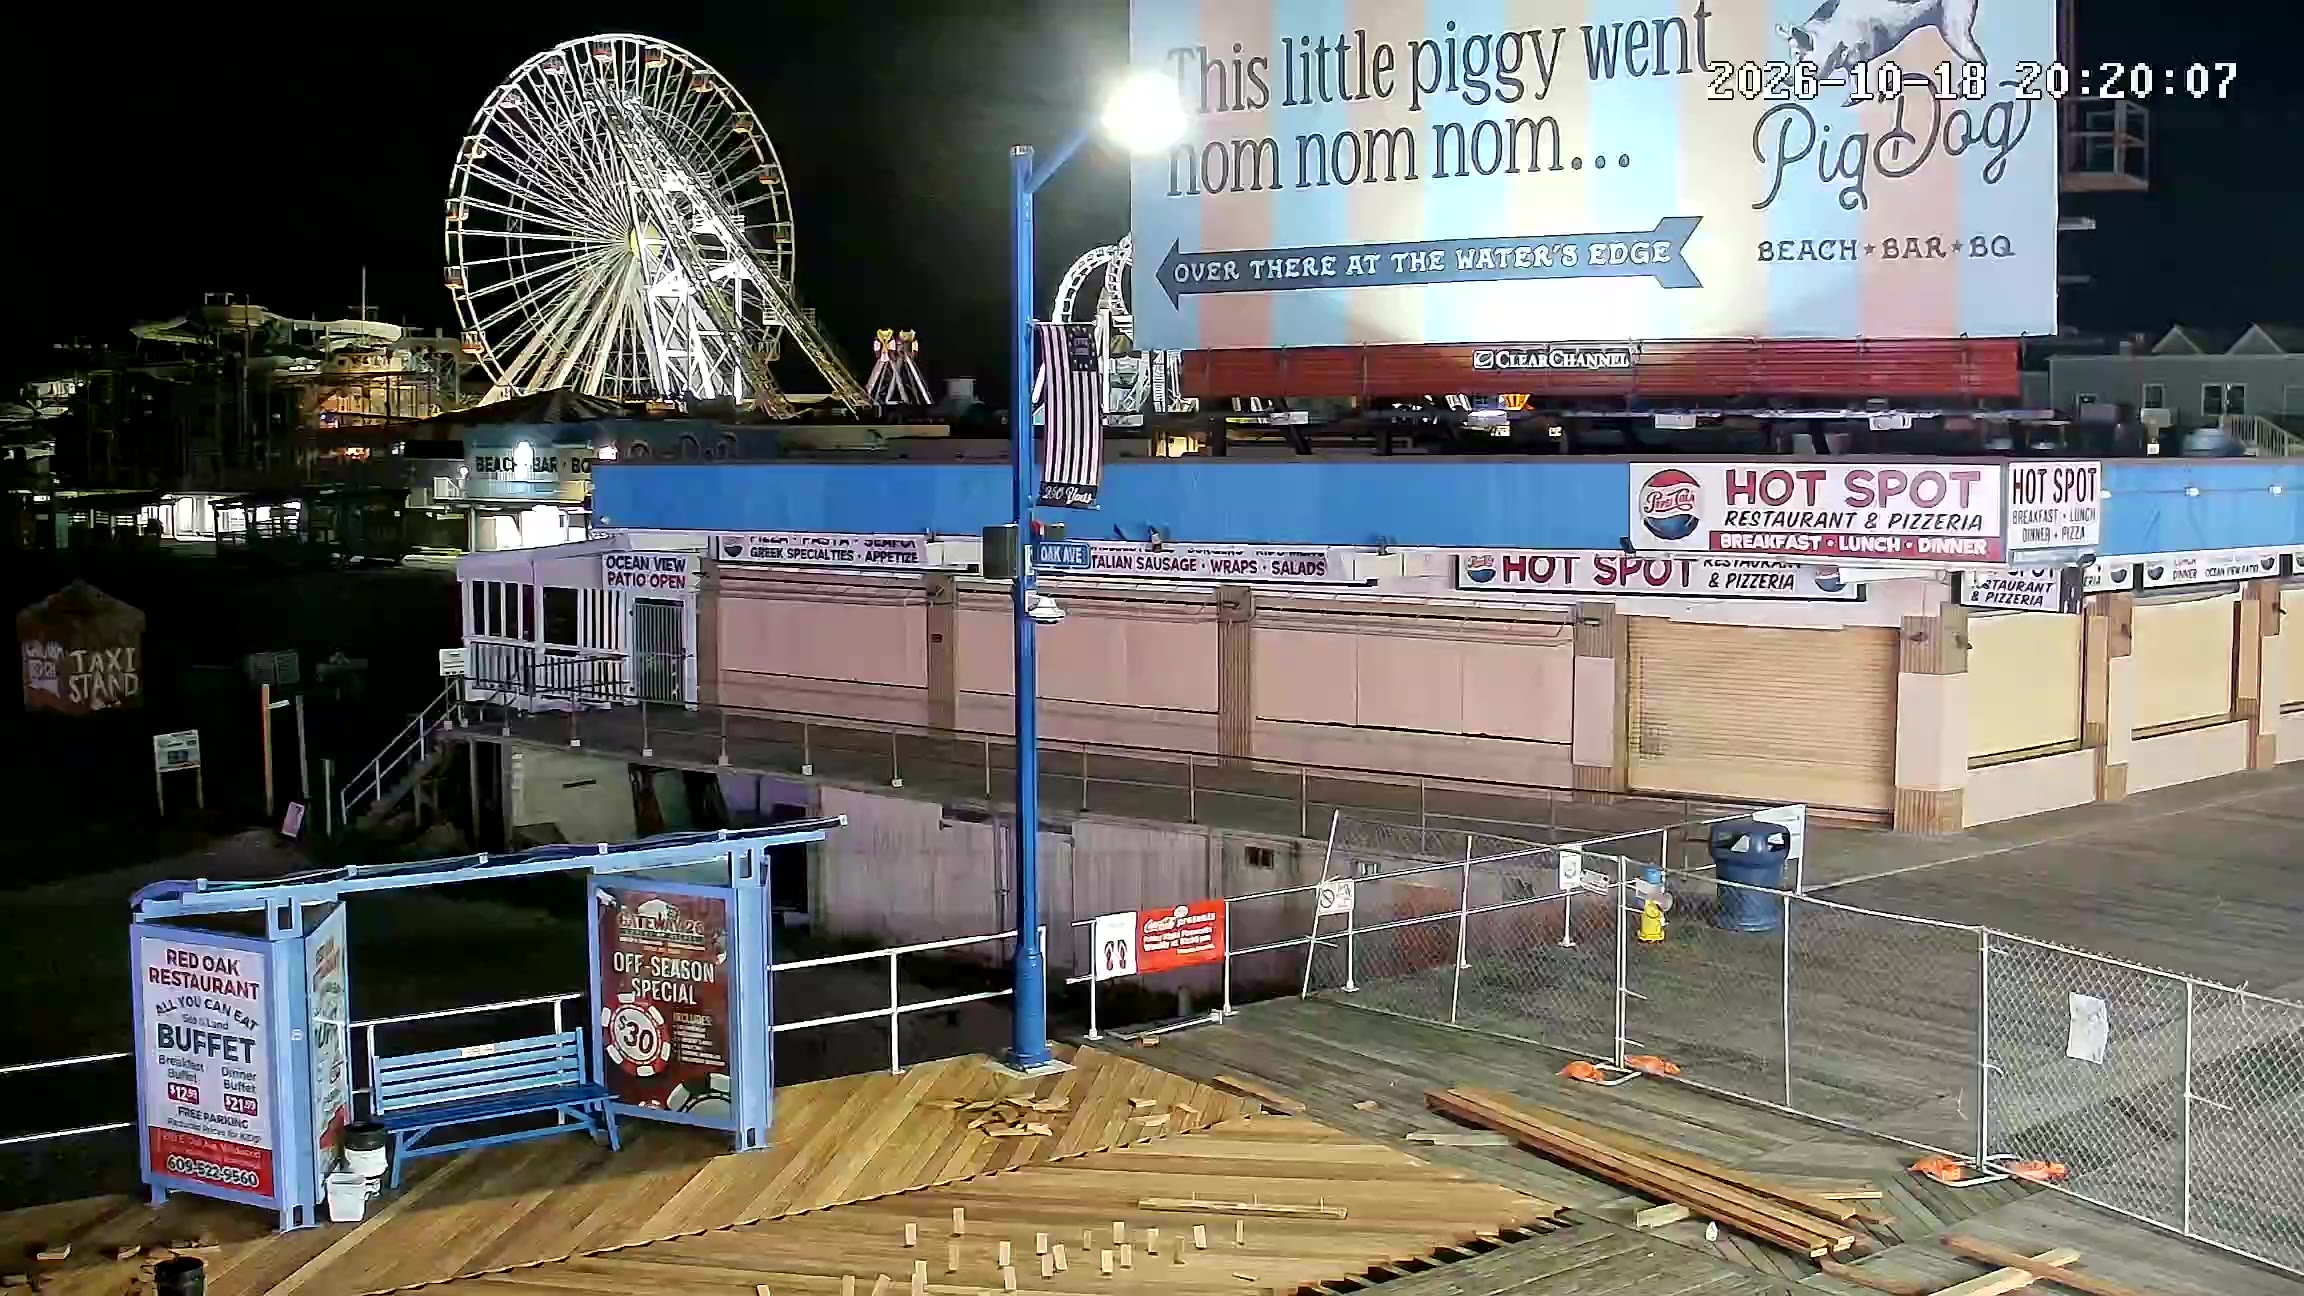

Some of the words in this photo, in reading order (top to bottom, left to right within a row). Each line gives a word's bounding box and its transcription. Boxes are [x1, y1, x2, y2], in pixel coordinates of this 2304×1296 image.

[1168, 43, 1270, 114] This
[1282, 29, 1395, 106] little
[1408, 20, 1566, 112] piggy
[1582, 0, 1712, 81] went
[1167, 134, 1283, 199] nom
[1296, 124, 1417, 188] nom
[1757, 238, 1859, 264] BEACH
[1881, 236, 1948, 261] BAR
[1969, 234, 2017, 260] BQ
[1174, 258, 1240, 285] OVER
[1249, 254, 1337, 281] THERE
[1346, 253, 1382, 276] AT
[1390, 250, 1446, 274] THE
[1455, 243, 1578, 271] WATER'S
[1588, 240, 1672, 266] EDGE
[476, 455, 514, 473] BEAC
[1725, 468, 1827, 508] HOT
[1843, 469, 1983, 510] SPOT
[2012, 467, 2049, 506] HOT
[2053, 466, 2098, 505] SPOT
[1723, 509, 1859, 531] RESTAURANT
[1864, 512, 1878, 530] &
[1887, 513, 1984, 532] PIZZERIA
[2012, 509, 2059, 525] BREAKFAST
[2069, 507, 2096, 523] LUNCH
[1719, 531, 1822, 552] BREAKFAST
[1836, 534, 1899, 554] LUNCH
[1916, 536, 1987, 556] DINNER
[2022, 527, 2051, 544] DINNER
[2061, 525, 2086, 541] PIZZA
[605, 555, 650, 571] OCEAN
[652, 556, 687, 573] VIEW
[749, 547, 785, 561] GREEK
[786, 548, 855, 563] SPECIALTIES
[1040, 545, 1061, 562] OAK
[1063, 545, 1082, 564] AVE
[1091, 553, 1133, 572] TALIAN
[1136, 555, 1198, 574] SAUSAGE
[1209, 557, 1259, 576] WRAPS
[1271, 559, 1327, 578] SALADS
[607, 571, 647, 588] PATIO
[649, 573, 687, 590] OPEN
[1502, 555, 1581, 585] HOT
[1594, 555, 1697, 588] SPOT
[1708, 572, 1721, 588] &
[1724, 573, 1795, 592] PIZZERIA
[1971, 577, 2056, 596] STAURANT
[1971, 590, 1980, 603] &
[1985, 591, 2045, 608] PIZZERIA
[69, 647, 136, 673] TAXI
[69, 672, 139, 704] STAND
[166, 948, 199, 969] RED
[202, 955, 240, 977] OAK
[149, 966, 260, 1000] RESTAURANT
[631, 976, 697, 1005] SPECIAL
[156, 999, 178, 1015] ALL
[178, 995, 202, 1008] YOU
[203, 998, 231, 1017] CAN
[234, 1009, 259, 1031] EAT
[207, 1017, 229, 1030] Land
[157, 1023, 256, 1064] BUFFET
[223, 1078, 257, 1094] Buffet
[177, 1106, 203, 1122] FREE
[203, 1112, 249, 1130] PARKING
